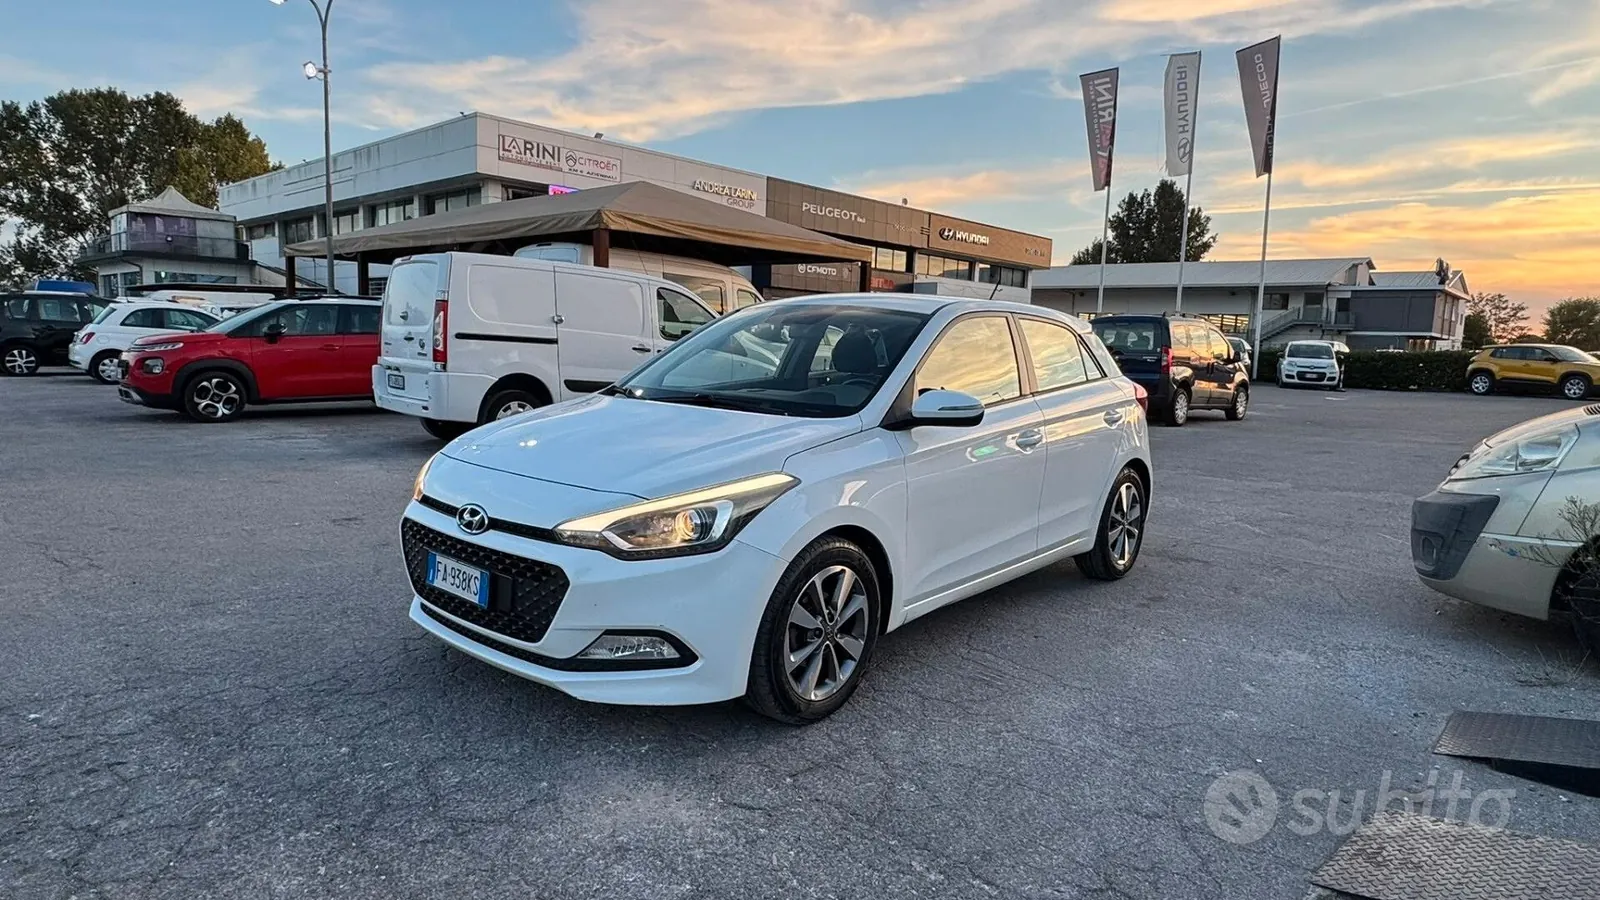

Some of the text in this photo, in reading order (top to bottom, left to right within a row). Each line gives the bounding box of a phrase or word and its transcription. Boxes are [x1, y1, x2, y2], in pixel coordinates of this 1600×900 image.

[502, 135, 561, 163] LARINI
[694, 179, 758, 201] ANDREA LARINI
[726, 198, 755, 209] GROUP
[802, 202, 857, 221] PEUGEOT
[955, 230, 990, 246] HYUNDAI
[807, 265, 837, 275] CFMOTO
